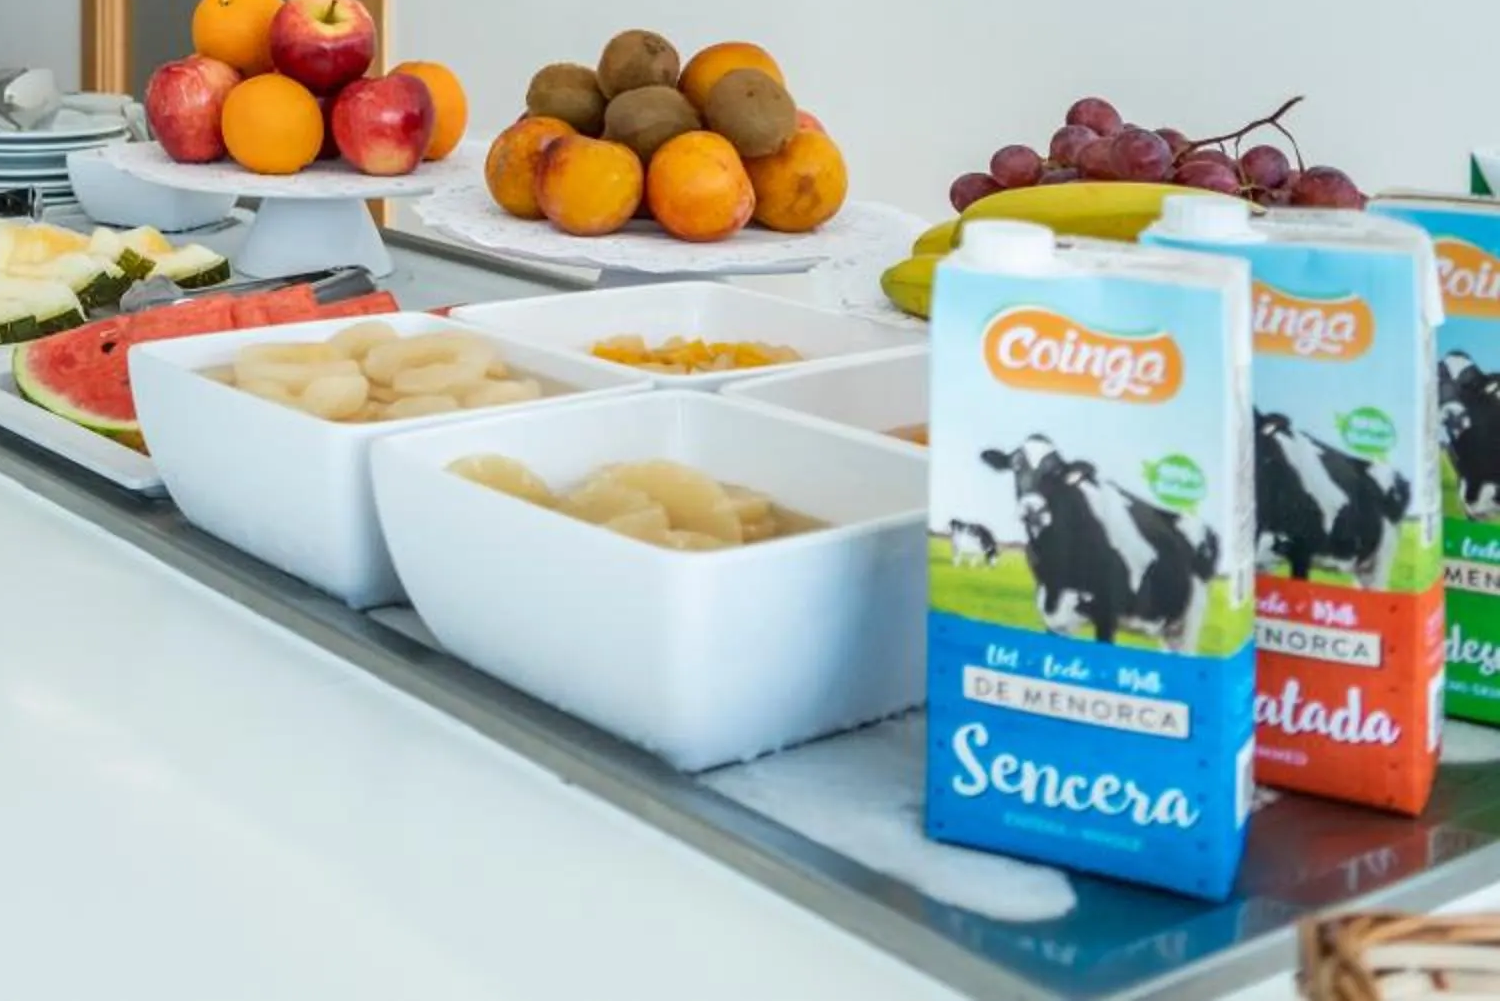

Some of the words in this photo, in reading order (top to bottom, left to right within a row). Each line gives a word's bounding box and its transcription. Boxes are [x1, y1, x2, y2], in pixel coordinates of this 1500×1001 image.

[998, 326, 1166, 397] Coinga
[1255, 624, 1371, 658] NORCA
[973, 676, 1011, 698] DE
[1023, 686, 1180, 733] MENORCA
[953, 722, 1199, 829] Sencera
